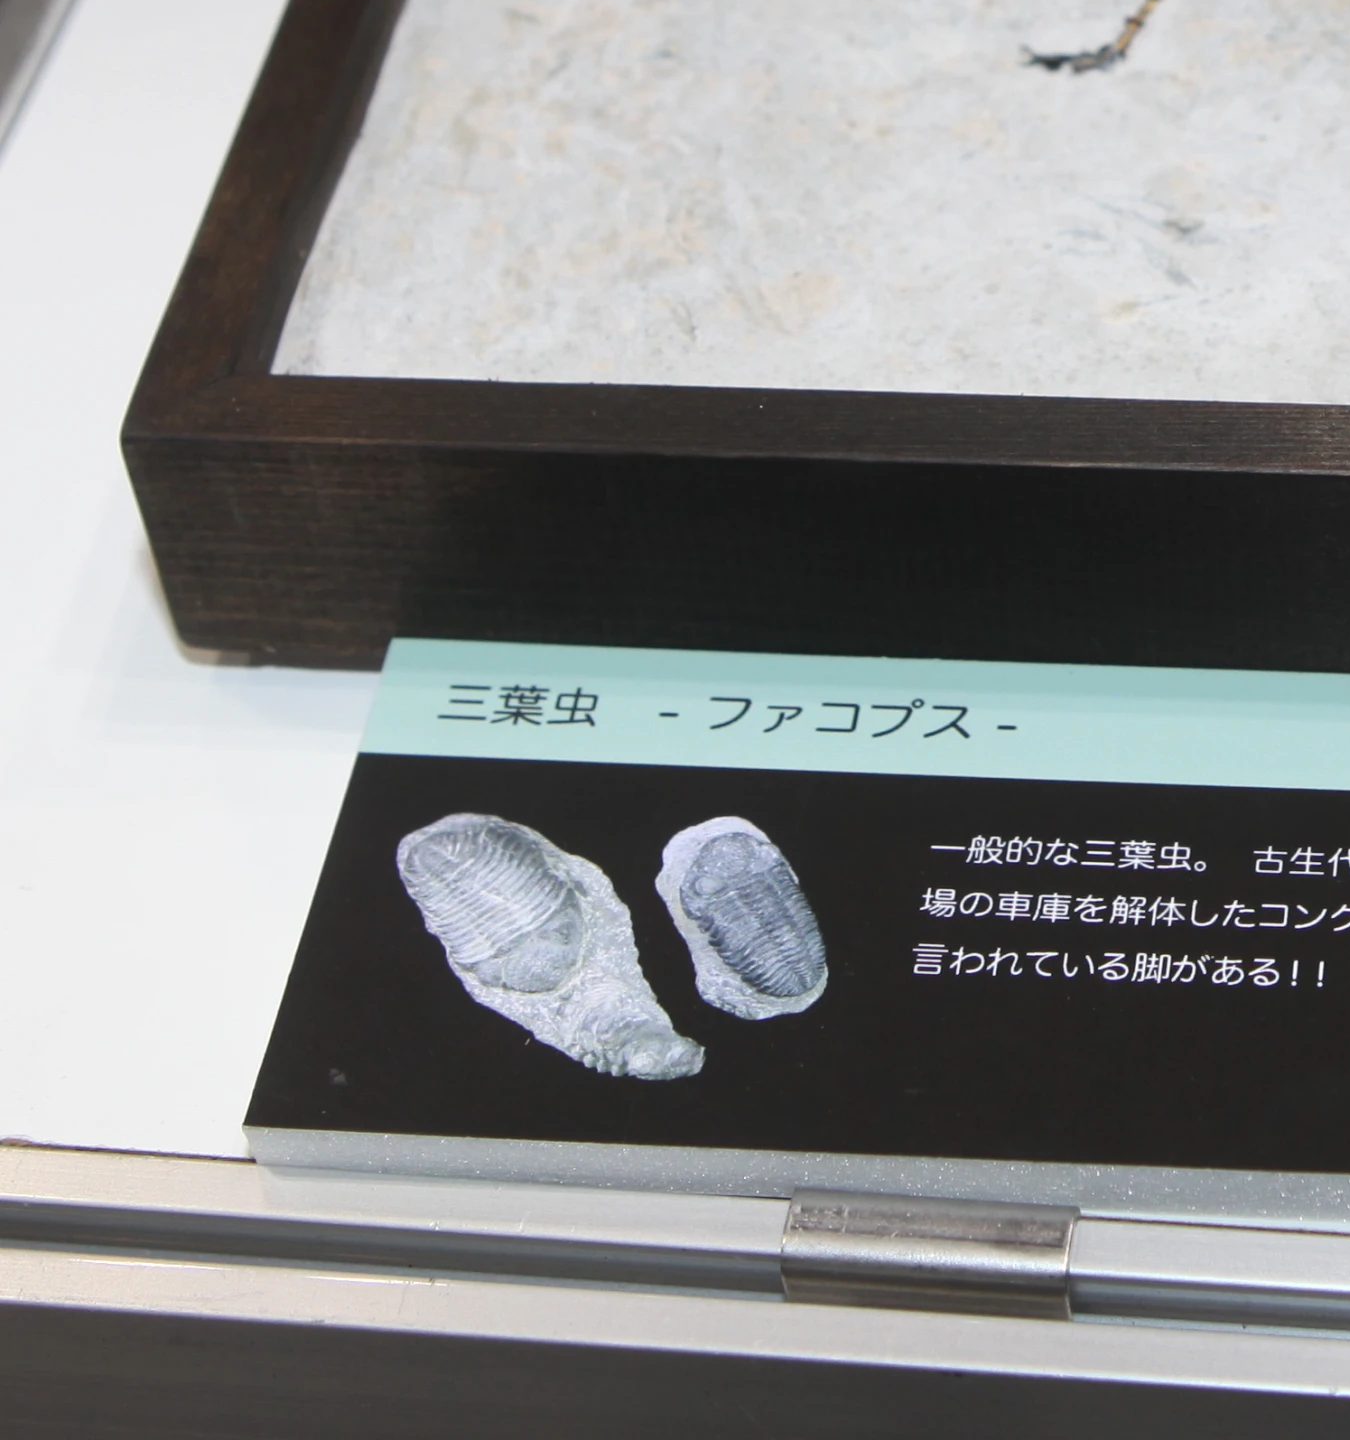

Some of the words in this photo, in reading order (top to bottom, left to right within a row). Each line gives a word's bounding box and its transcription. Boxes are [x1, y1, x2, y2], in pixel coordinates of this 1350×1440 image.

[438, 684, 598, 728] 三葉虫
[710, 697, 970, 739] ファコプス
